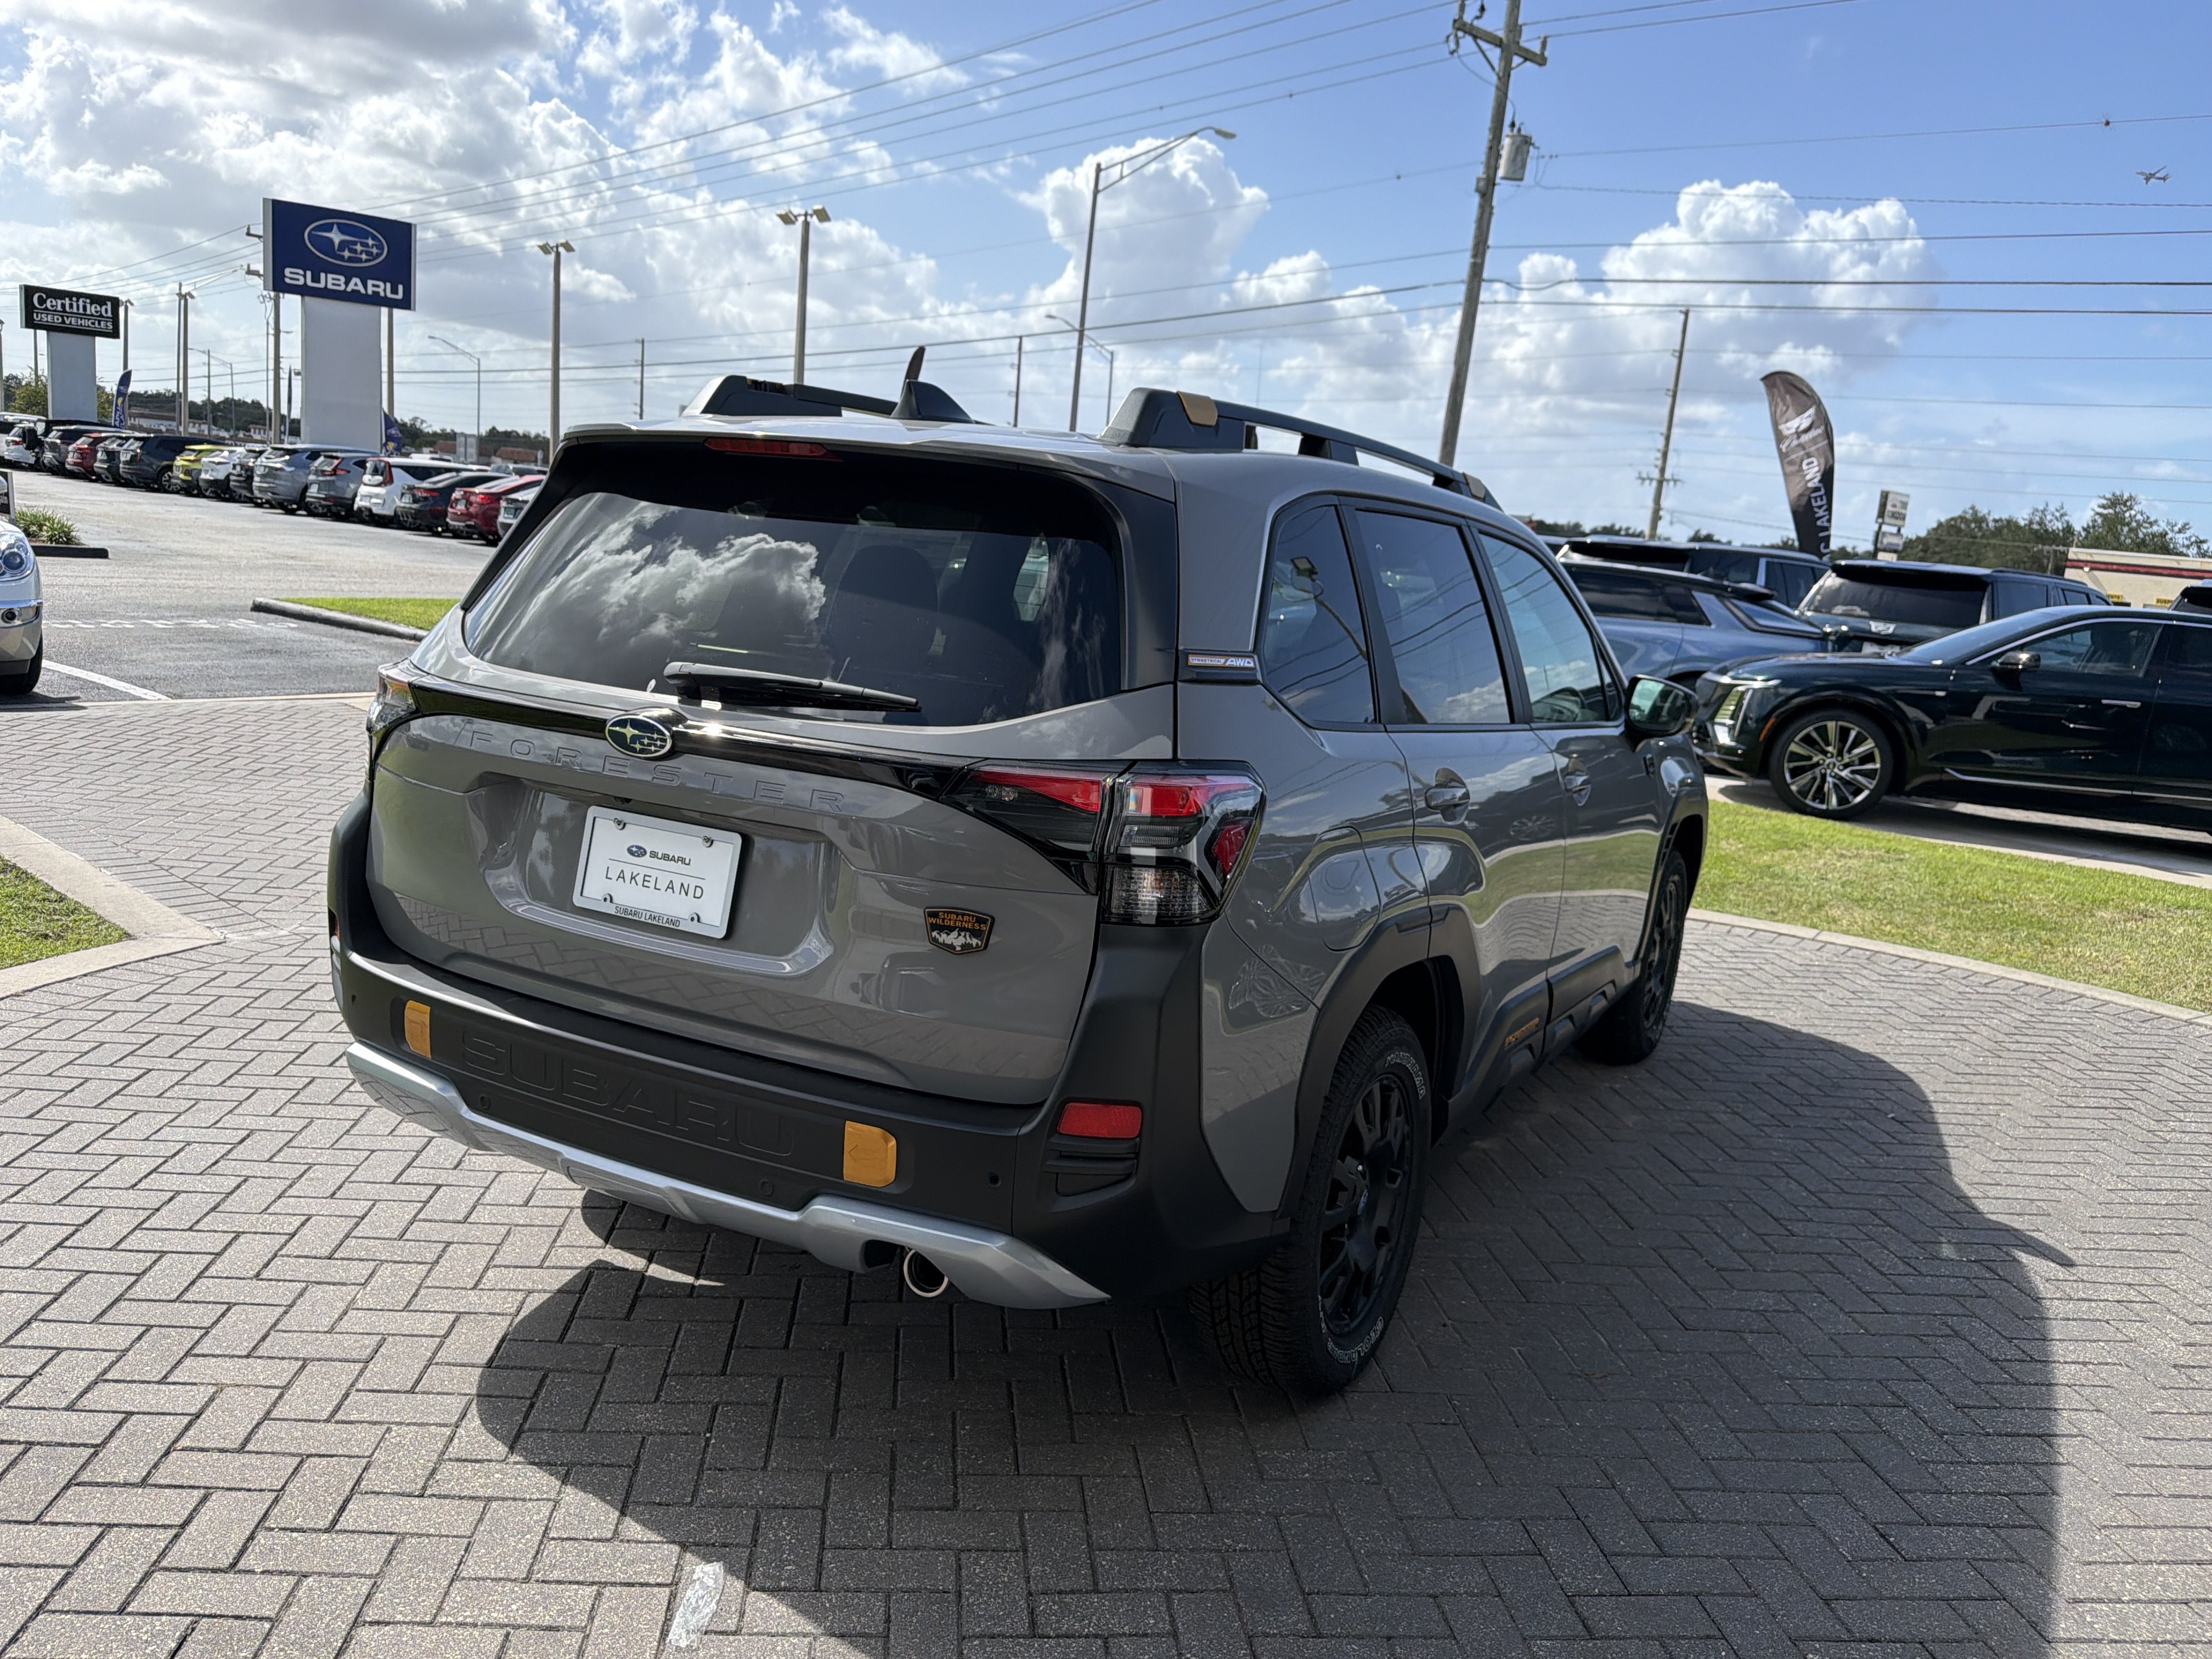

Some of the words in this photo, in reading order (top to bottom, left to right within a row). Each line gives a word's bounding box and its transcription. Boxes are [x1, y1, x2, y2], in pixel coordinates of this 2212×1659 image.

[284, 267, 403, 300] SUBARU
[33, 292, 112, 317] Certified
[33, 313, 62, 323] USED
[64, 316, 113, 330] VEHICLES
[1226, 658, 1255, 667] AWD
[469, 730, 846, 813] FORESTER
[649, 850, 691, 866] SUBARU
[605, 866, 704, 899] LAKELAND
[614, 906, 643, 919] SUBARU
[644, 911, 681, 928] LAKELAND
[928, 917, 986, 931] WILDERNESS
[939, 912, 976, 923] SUBARU
[461, 1029, 794, 1156] SUBARU
